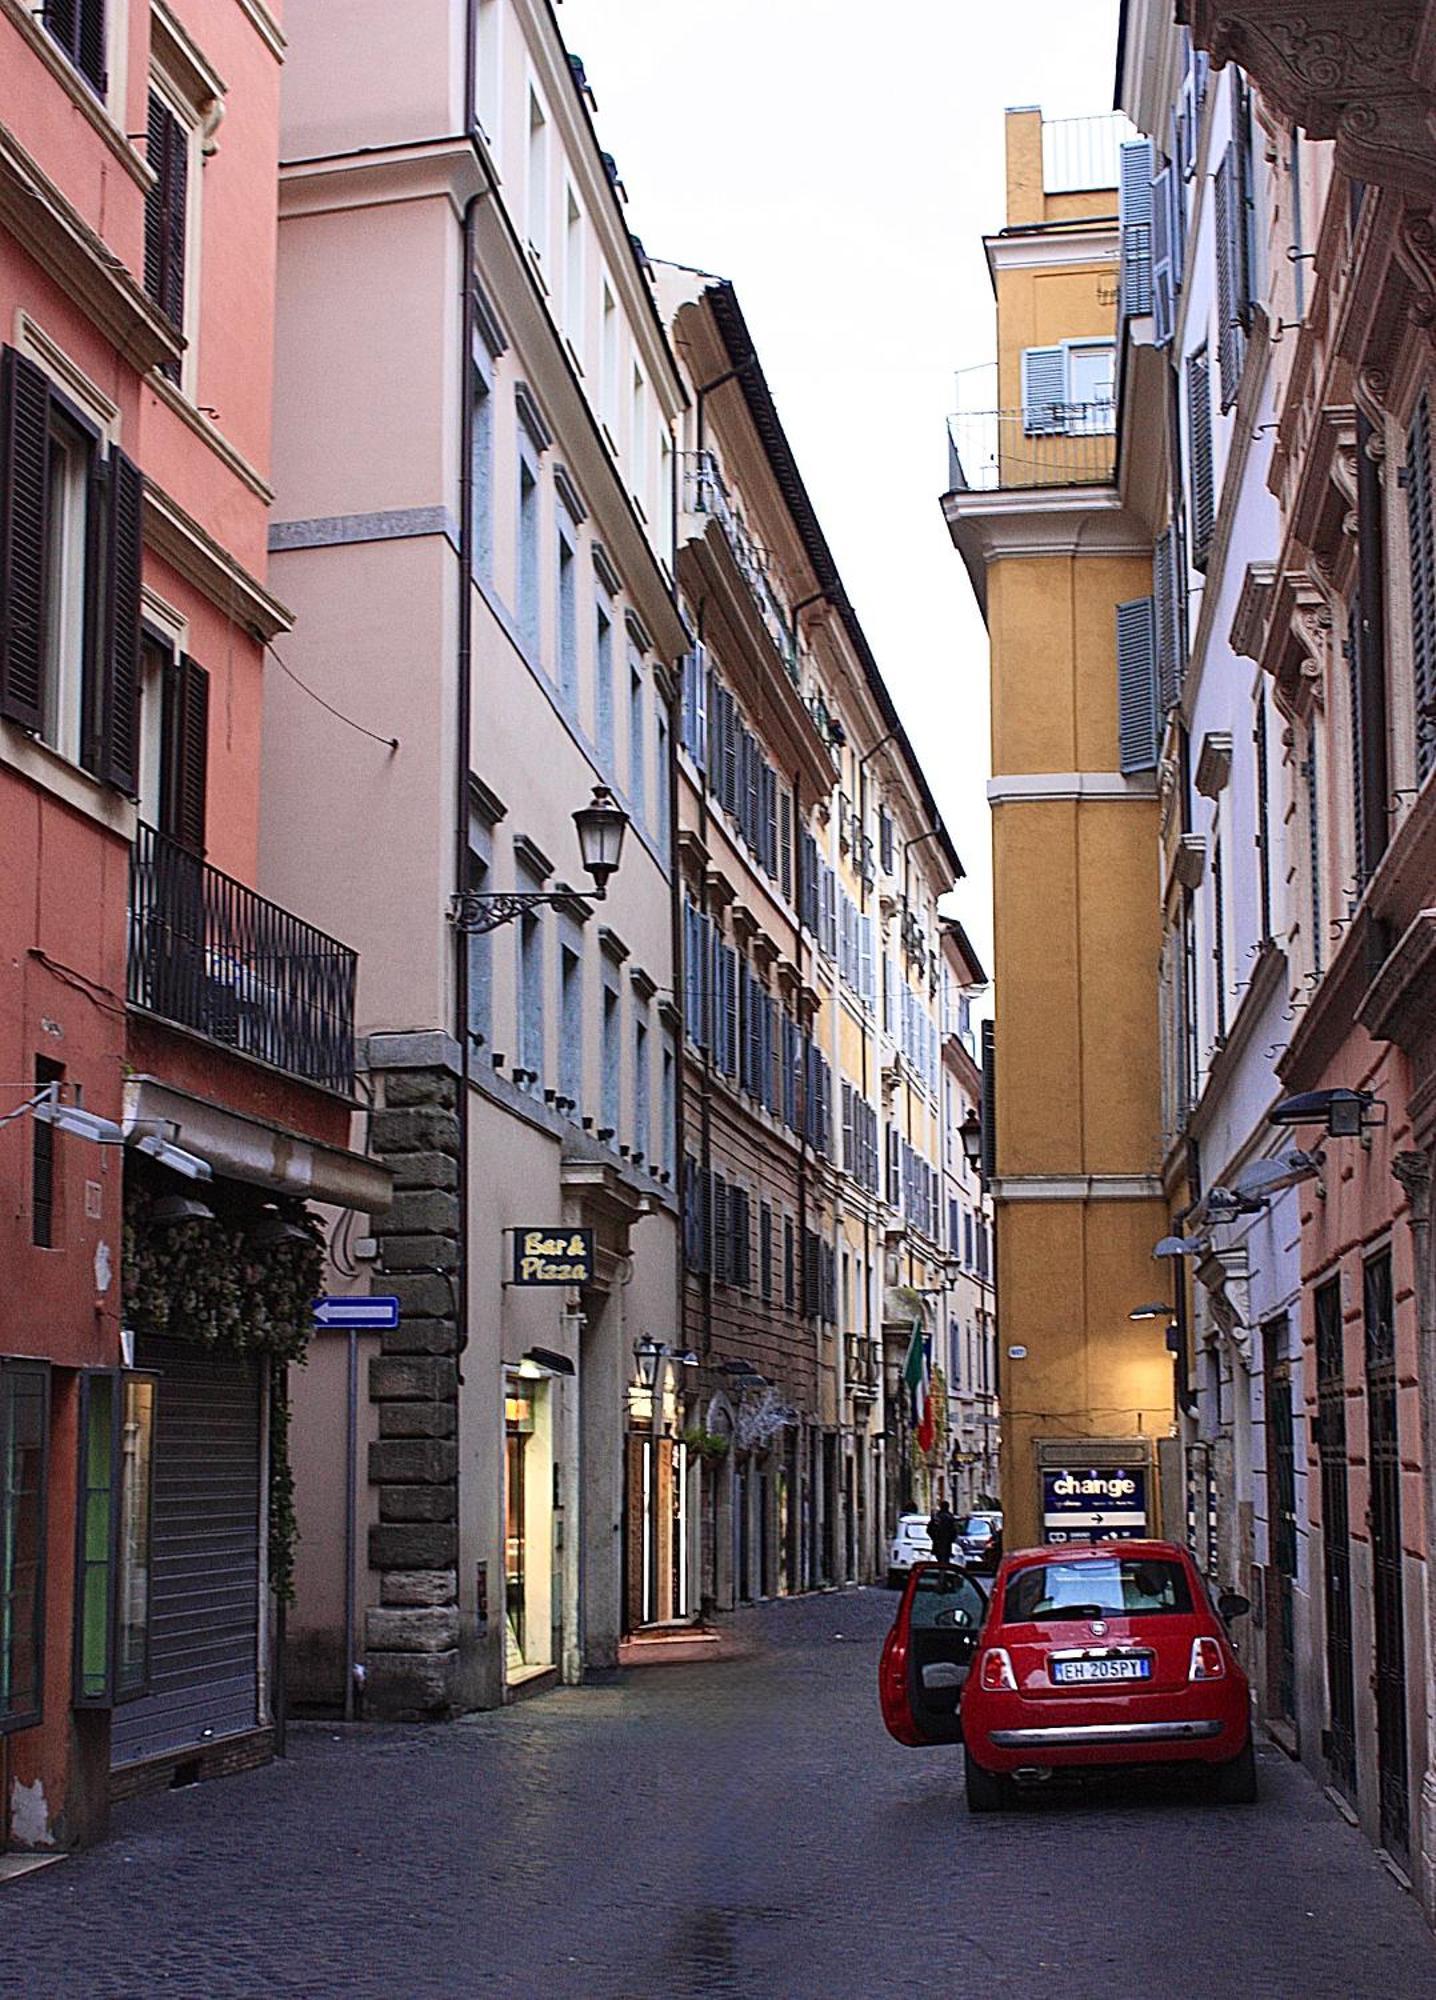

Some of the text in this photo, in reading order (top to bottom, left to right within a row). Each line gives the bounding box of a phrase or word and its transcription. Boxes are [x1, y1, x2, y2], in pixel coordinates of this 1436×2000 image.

[524, 1232, 587, 1256] Bar &
[520, 1256, 589, 1280] Pizza
[1053, 1475, 1136, 1498] change
